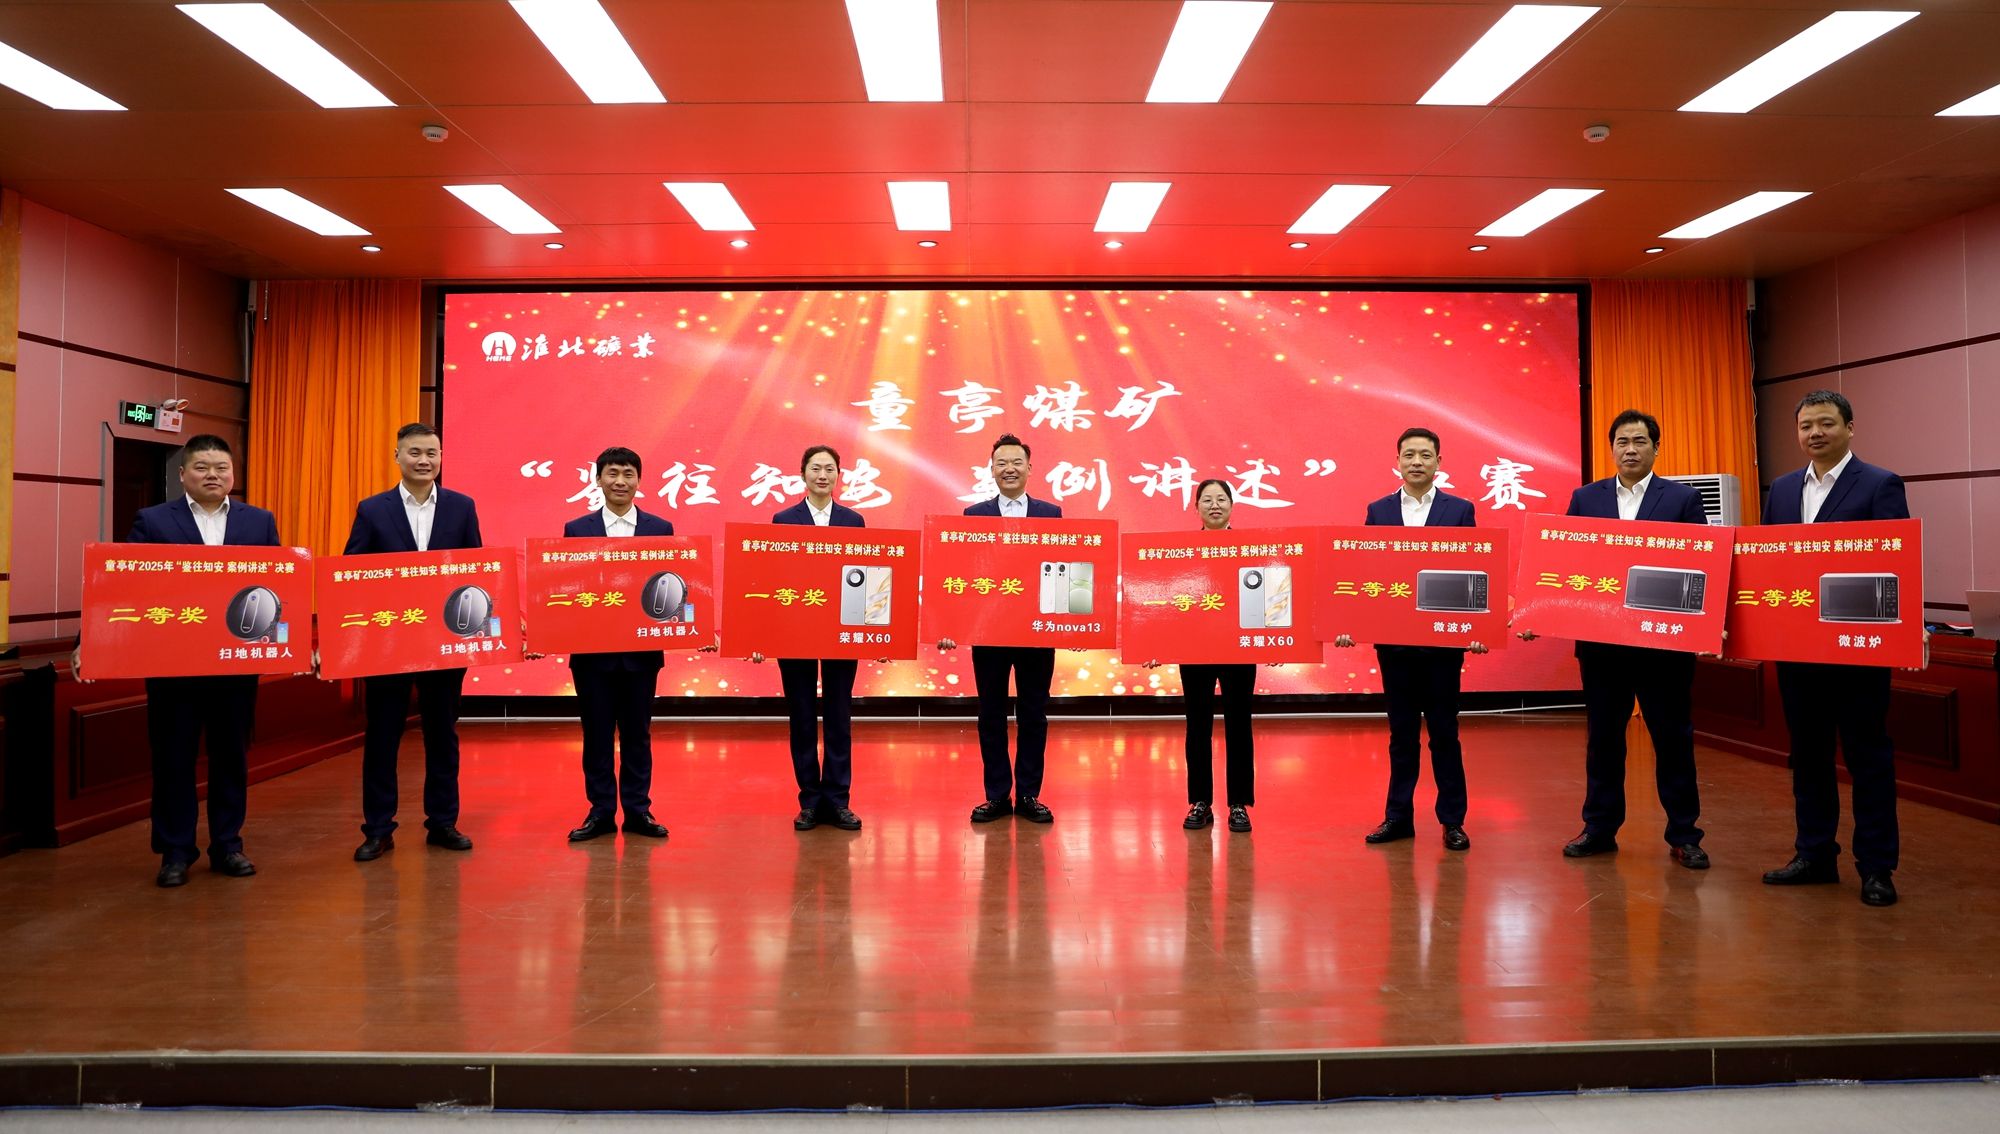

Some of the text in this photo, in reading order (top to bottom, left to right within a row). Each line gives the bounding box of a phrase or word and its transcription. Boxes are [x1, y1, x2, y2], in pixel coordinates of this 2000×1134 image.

[850, 380, 1182, 434] 童亭煤矿
[942, 576, 1025, 596] 特等奖
[1333, 581, 1413, 598] 三等奖
[1535, 572, 1622, 595] 三等奖
[546, 591, 626, 608] 二等奖
[744, 588, 828, 607] 一等奖
[1142, 593, 1226, 612] 一等奖
[1735, 589, 1815, 607] 三等奖
[108, 606, 208, 625] 二等奖
[340, 607, 428, 628] 二等奖
[636, 625, 699, 638] 扫地机器人
[1031, 619, 1101, 633] 华为nova13
[1433, 621, 1472, 633] 微波炉
[1640, 620, 1684, 635] 微波炉
[839, 631, 891, 644] 荣耀X60
[1239, 635, 1294, 648] 荣耀X60
[1838, 634, 1882, 648] 微波炉
[219, 646, 293, 660] 扫地机器人
[440, 640, 507, 656] 扫地机器人
